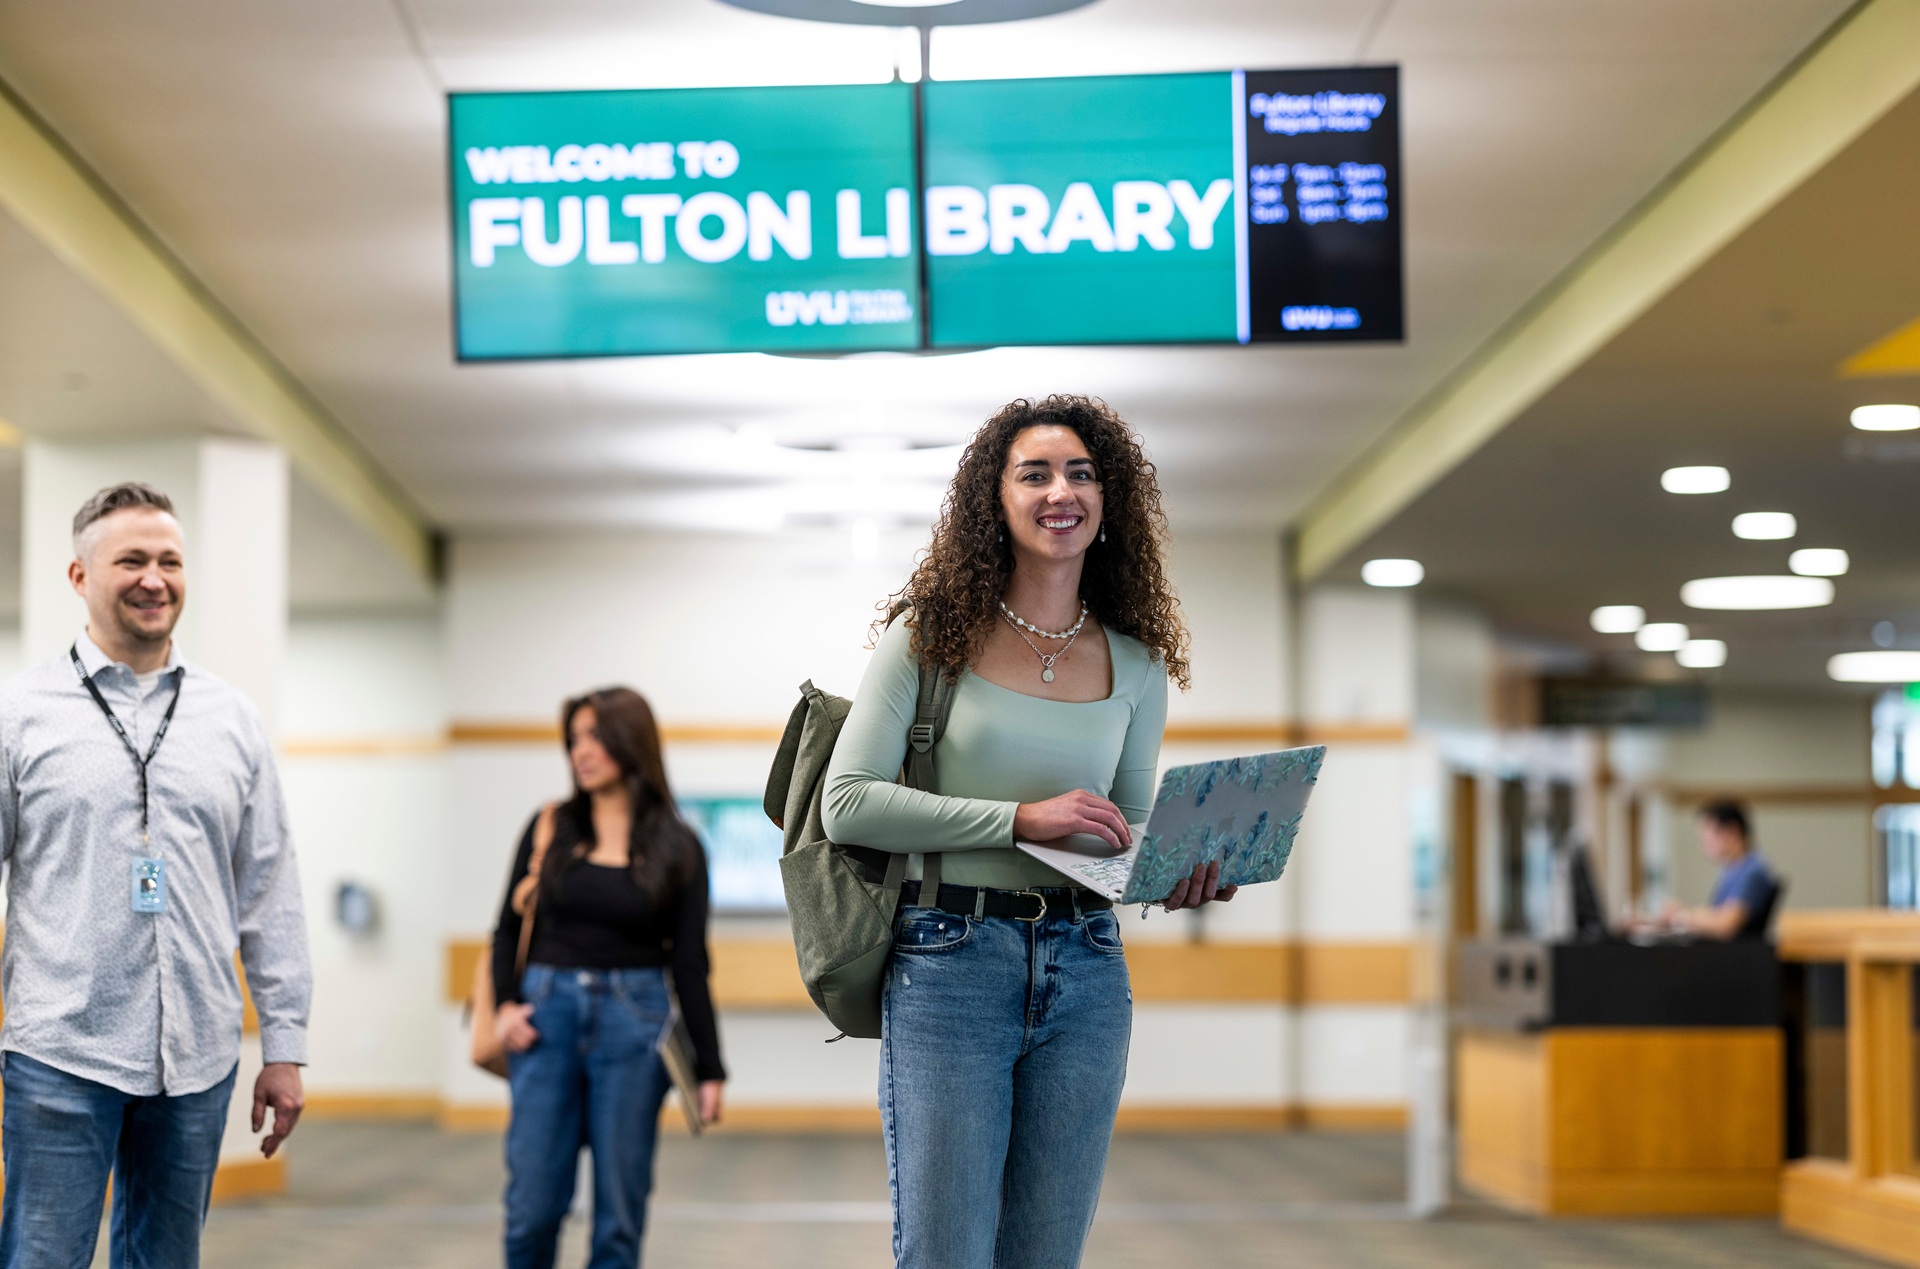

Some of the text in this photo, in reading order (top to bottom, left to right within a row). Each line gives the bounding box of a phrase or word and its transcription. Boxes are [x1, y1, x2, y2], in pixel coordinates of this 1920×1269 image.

[466, 141, 740, 184] WELCOME TO
[469, 190, 812, 267] FULTON
